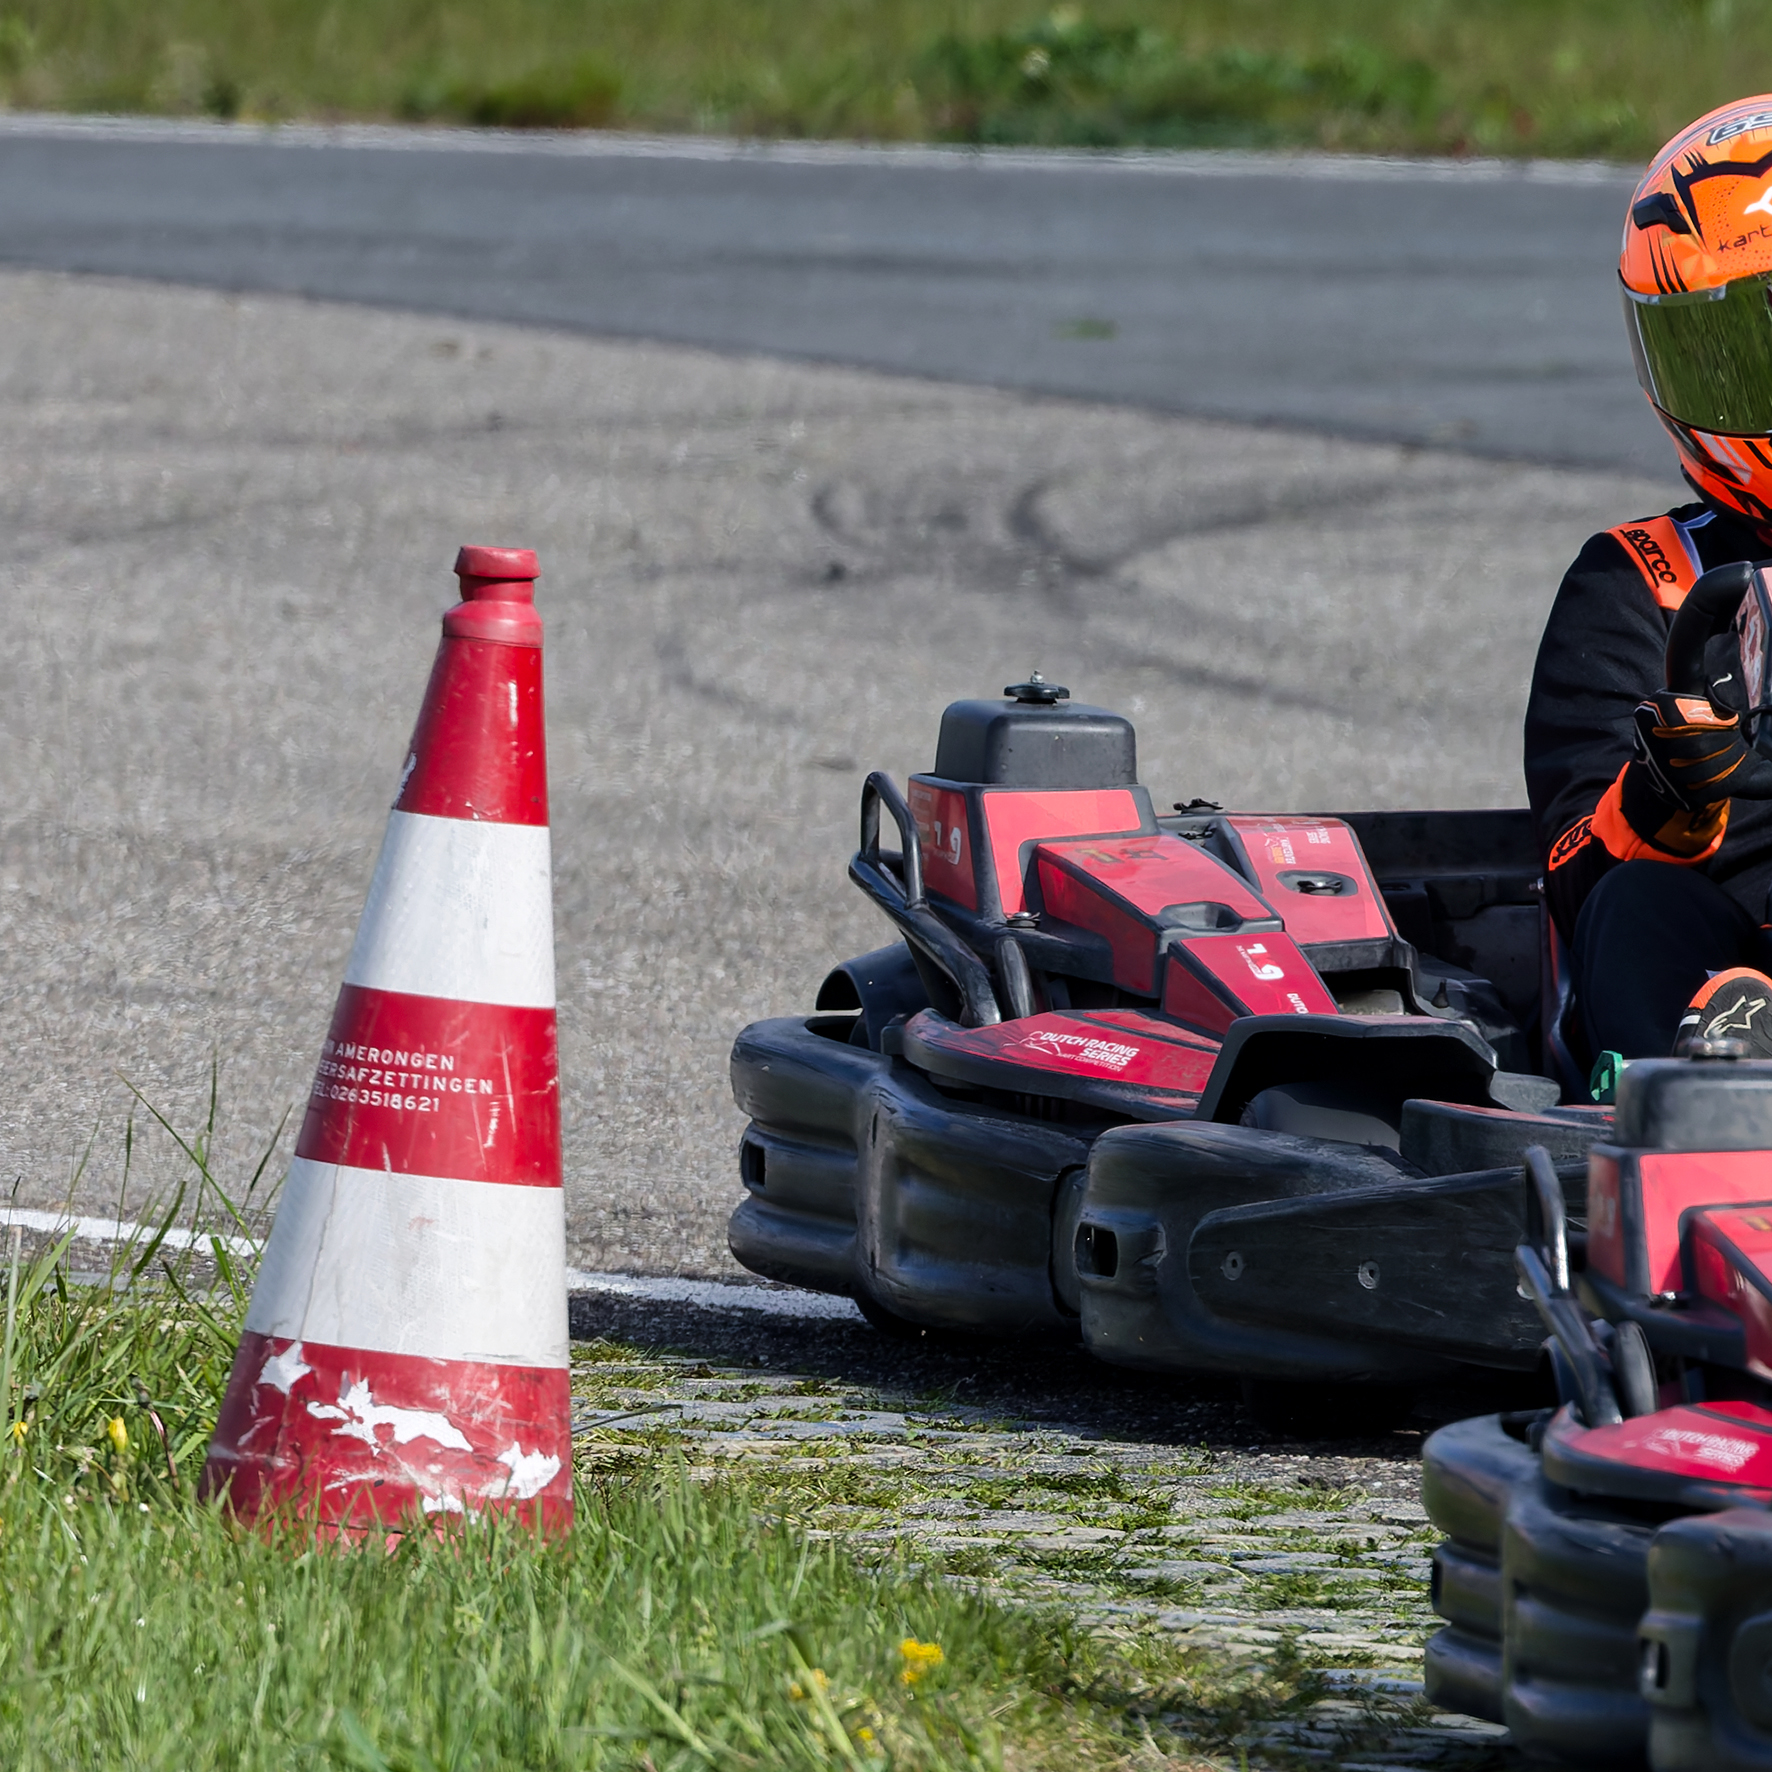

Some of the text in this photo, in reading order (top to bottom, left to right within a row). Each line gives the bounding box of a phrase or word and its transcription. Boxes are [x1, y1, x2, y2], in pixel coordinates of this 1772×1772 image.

[1624, 529, 1677, 584] sparco
[1286, 993, 1309, 1014] DUTC
[336, 1042, 454, 1070] AMERONGEN
[1040, 1032, 1140, 1058] DUTCH RACING
[1079, 1047, 1131, 1066] SERIES
